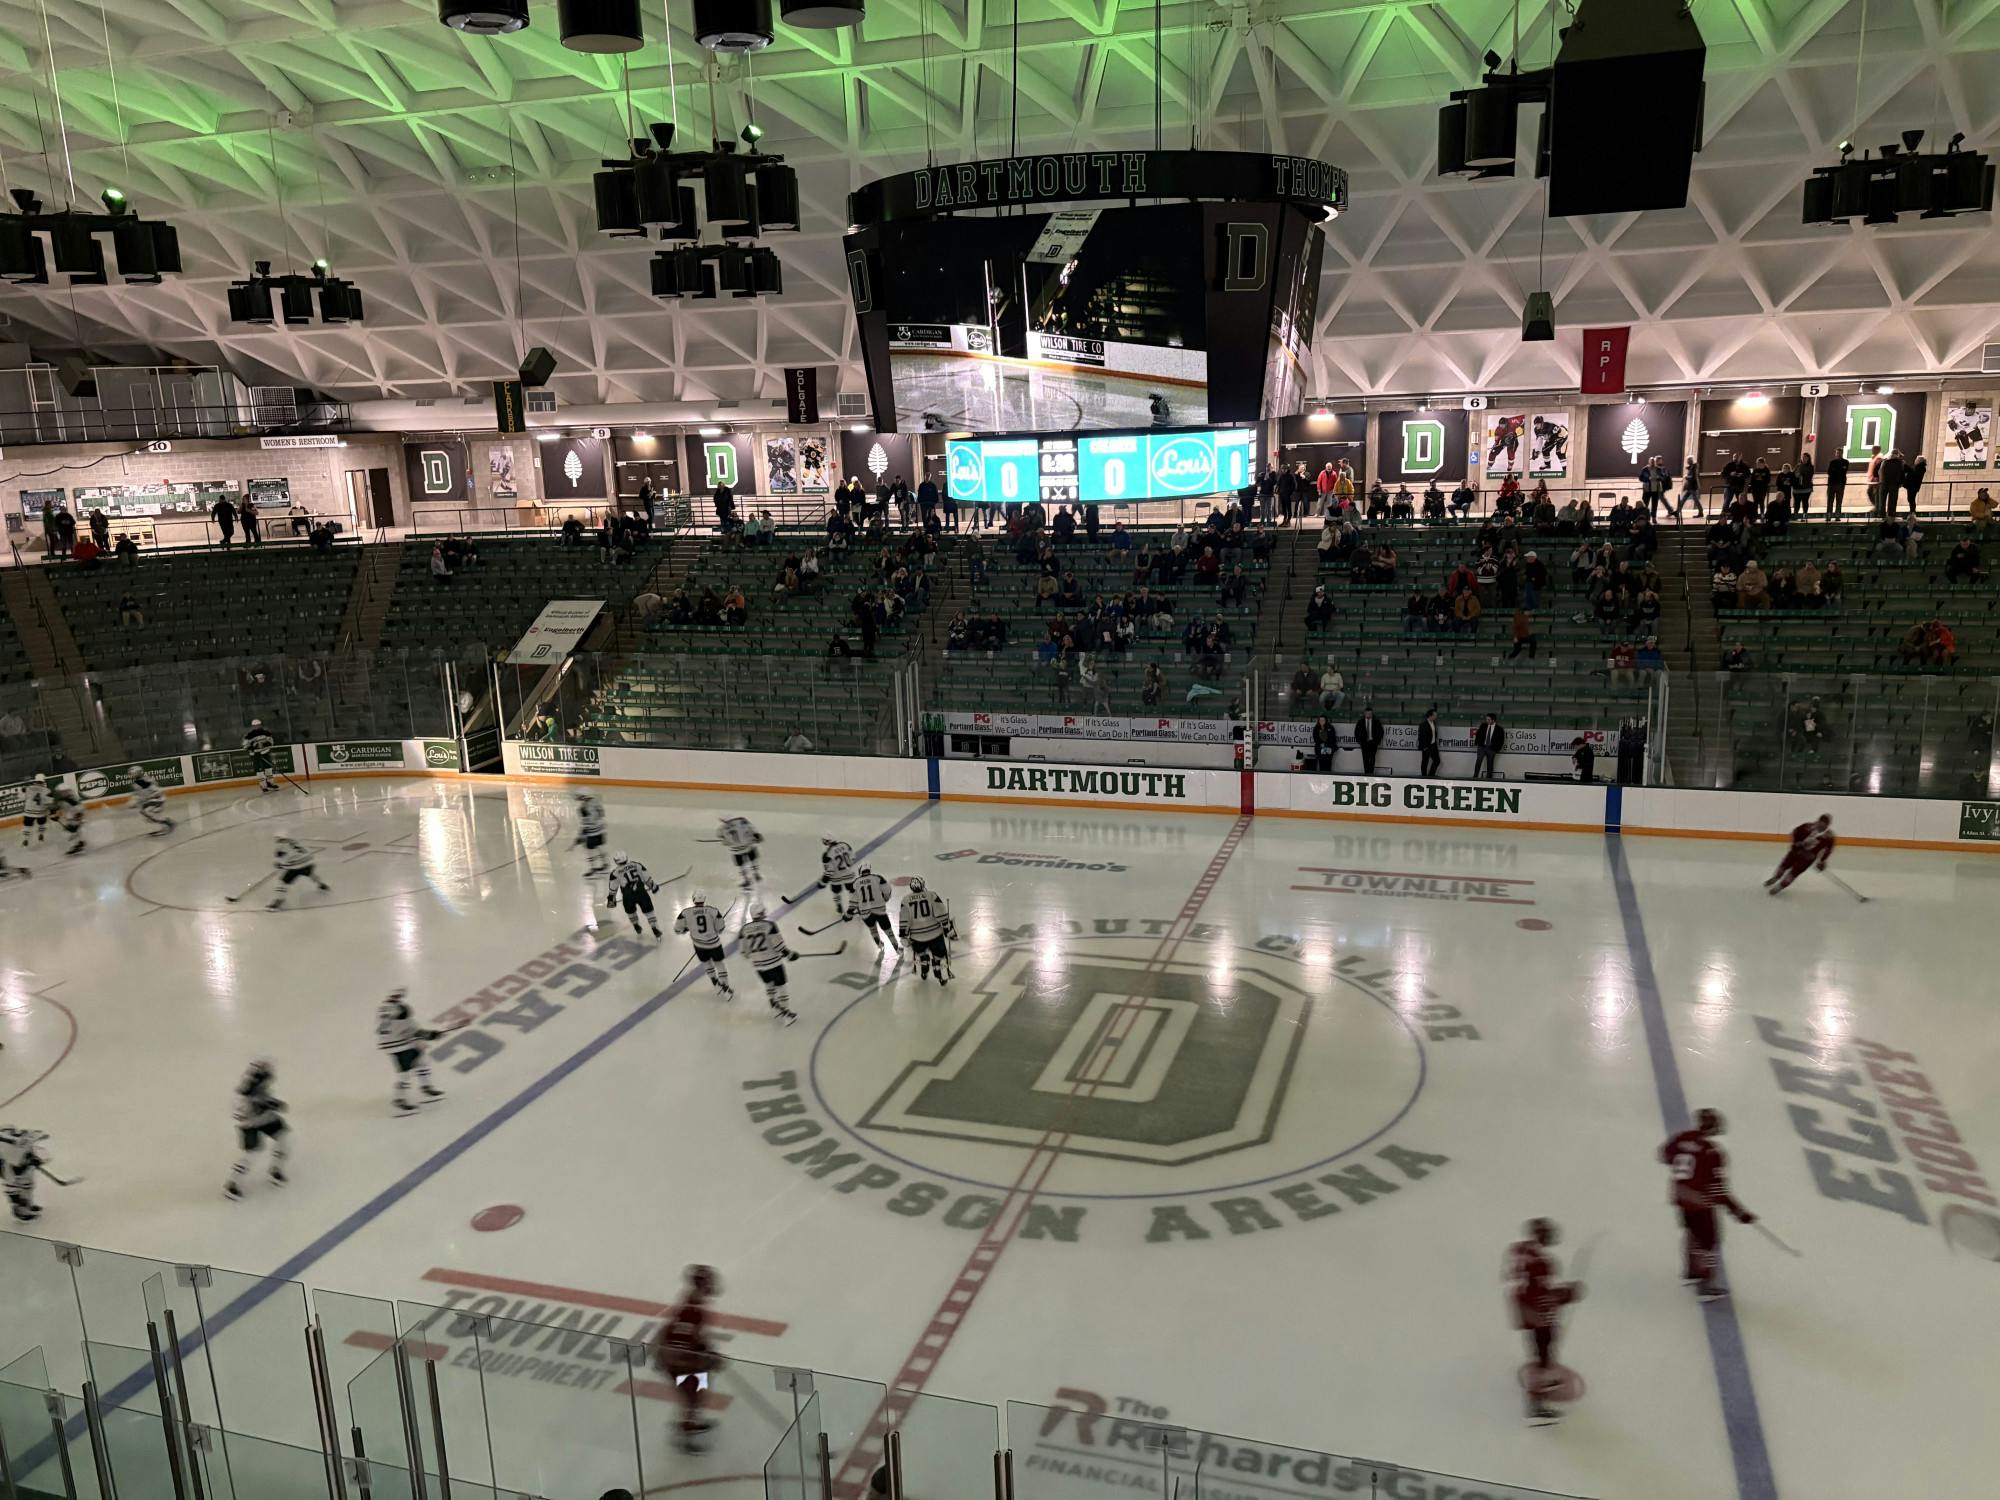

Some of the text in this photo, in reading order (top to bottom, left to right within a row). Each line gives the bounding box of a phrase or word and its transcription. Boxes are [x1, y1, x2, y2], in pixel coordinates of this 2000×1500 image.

[915, 154, 1147, 208] DARTMOUTH
[1272, 155, 1349, 207] THOMPS
[1225, 222, 1268, 291] D
[1040, 336, 1104, 354] WILSON TIRE CO.
[796, 370, 807, 423] COLGATE
[1807, 383, 1822, 398] 5
[1470, 397, 1480, 408] 6
[598, 429, 606, 437] 9
[1843, 403, 1898, 463] D
[152, 442, 167, 452] 10
[263, 436, 336, 447] WOMEN'S RESTROOM
[1401, 419, 1446, 475] D
[704, 442, 739, 489] D
[1156, 449, 1211, 477] Lou's
[421, 450, 453, 494] D
[1001, 461, 1018, 498] 0
[1104, 458, 1126, 497] 0
[973, 713, 991, 724] PG
[1010, 716, 1028, 724] Glass
[1085, 718, 1120, 728] If It's Glass
[1180, 721, 1216, 731] If It's Glass
[949, 722, 974, 732] Portland
[994, 726, 1036, 736] We Can Do It
[1038, 725, 1064, 735] Portland
[1085, 729, 1129, 739] We Can Do It
[1131, 728, 1158, 738] Portland
[1257, 722, 1276, 733] PG
[1280, 723, 1314, 733] If It's Glas
[1385, 727, 1418, 736] If It's Gla
[1505, 730, 1537, 740] t's Glass
[1180, 732, 1192, 741] We
[1193, 733, 1207, 741] Can
[1207, 733, 1219, 741] Do
[1220, 733, 1226, 742] It
[1280, 735, 1308, 744] We Can
[1385, 739, 1414, 748] We Can
[1438, 738, 1468, 747] Portland
[1583, 730, 1605, 742] PG
[428, 749, 449, 759] Lou's
[520, 746, 599, 762] WILSON TIRE CO.
[1503, 743, 1547, 752] e Can Do It
[80, 779, 107, 791] PEPSI
[987, 766, 1186, 798] DARTMOUTH
[33, 792, 42, 806] 4
[1332, 781, 1522, 814] BIG GREEN
[1963, 804, 1994, 823] Ivy
[834, 852, 851, 871] 20
[976, 854, 1128, 873] Domino's
[624, 869, 641, 885] 15
[1321, 873, 1511, 898] TOWNLINE
[860, 884, 874, 904] 11
[1361, 888, 1461, 901] EQUIPMENT
[909, 899, 931, 919] 70
[696, 915, 707, 933] 9
[747, 932, 769, 952] 22
[431, 942, 582, 1027] HOCKE
[430, 936, 661, 1074] ECAC
[856, 947, 1312, 1166] D
[742, 1070, 1452, 1243] THOMPSON ARENA
[448, 1346, 617, 1392] EQUIPMENT
[1115, 1396, 1169, 1420] The
[1025, 1454, 1159, 1493] FINANCIAL
